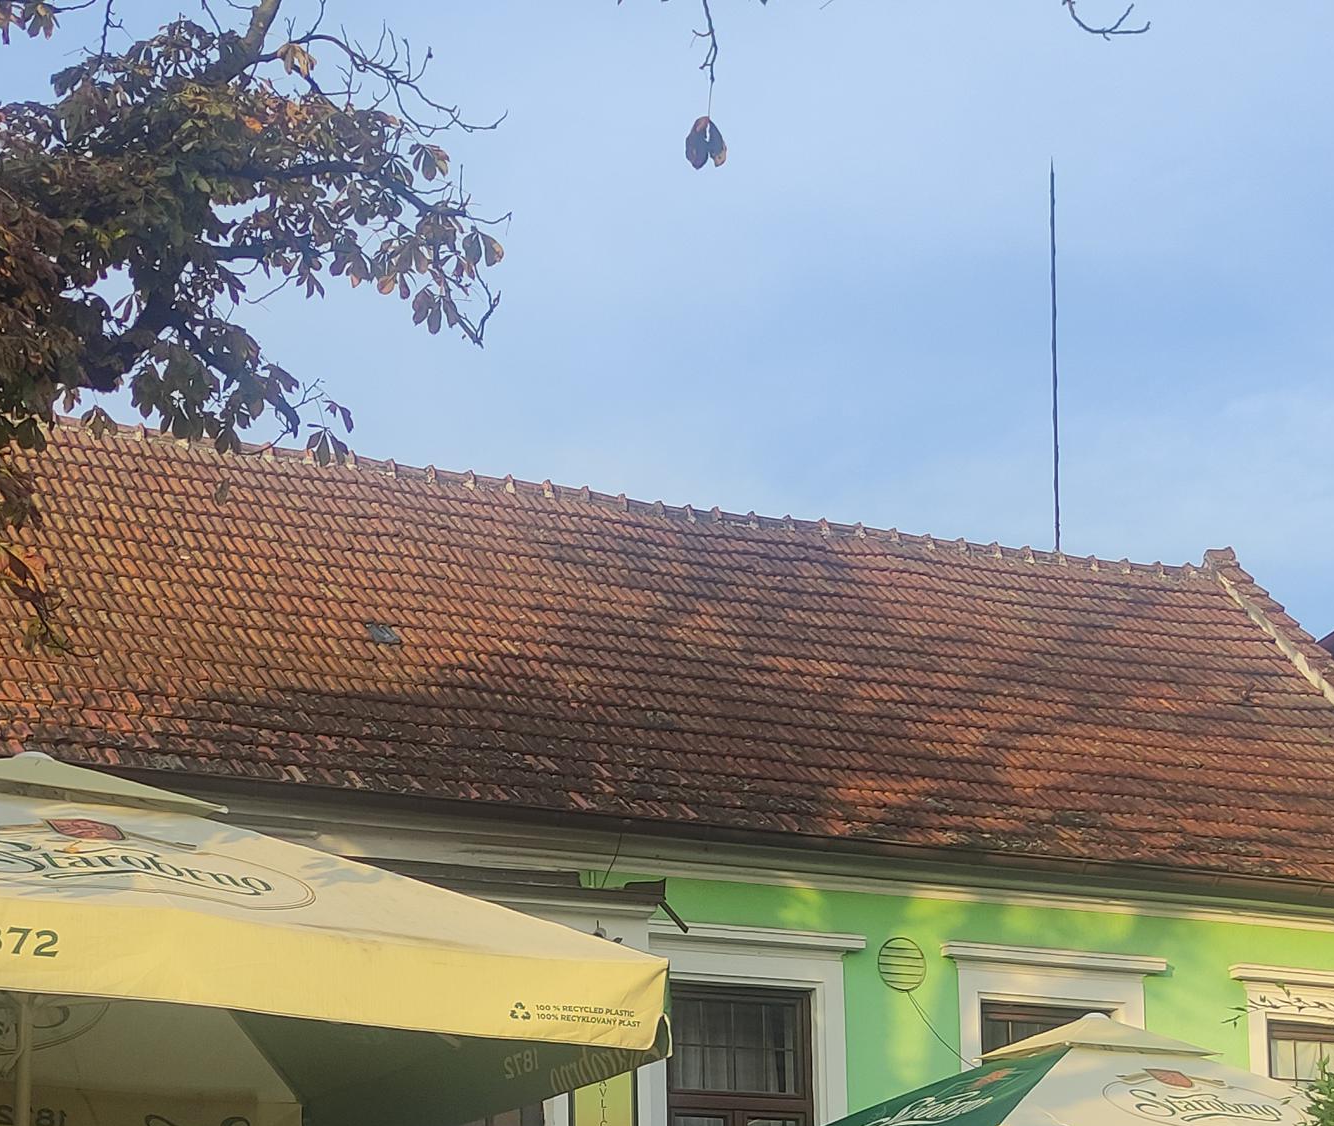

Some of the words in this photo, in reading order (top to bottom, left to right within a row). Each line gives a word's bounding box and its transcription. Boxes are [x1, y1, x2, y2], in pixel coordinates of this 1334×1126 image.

[562, 1005, 604, 1015] RECYCLED
[605, 1008, 635, 1018] PLASTIC
[536, 1012, 560, 1021] 100%
[560, 1014, 617, 1027] RECYKLOVANÝ
[618, 1019, 642, 1028] PLAST
